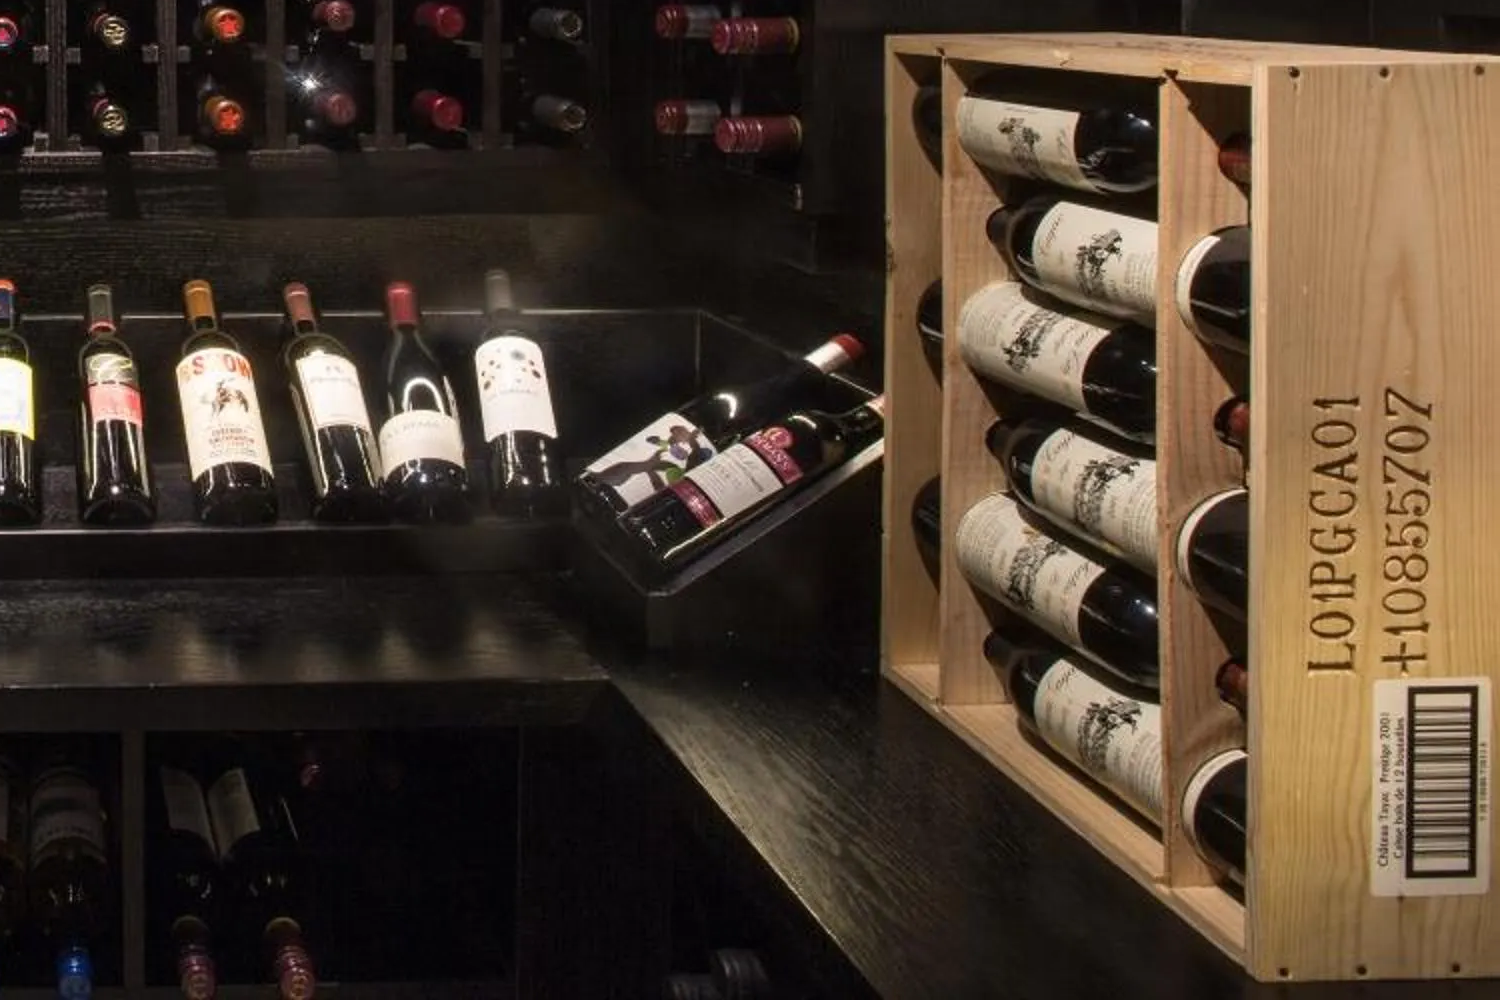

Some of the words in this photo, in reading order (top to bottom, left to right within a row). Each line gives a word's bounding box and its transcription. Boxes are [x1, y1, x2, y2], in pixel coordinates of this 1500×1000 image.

[1379, 711, 1390, 739] 2001
[1393, 788, 1405, 802] de
[1377, 824, 1390, 867] Château
